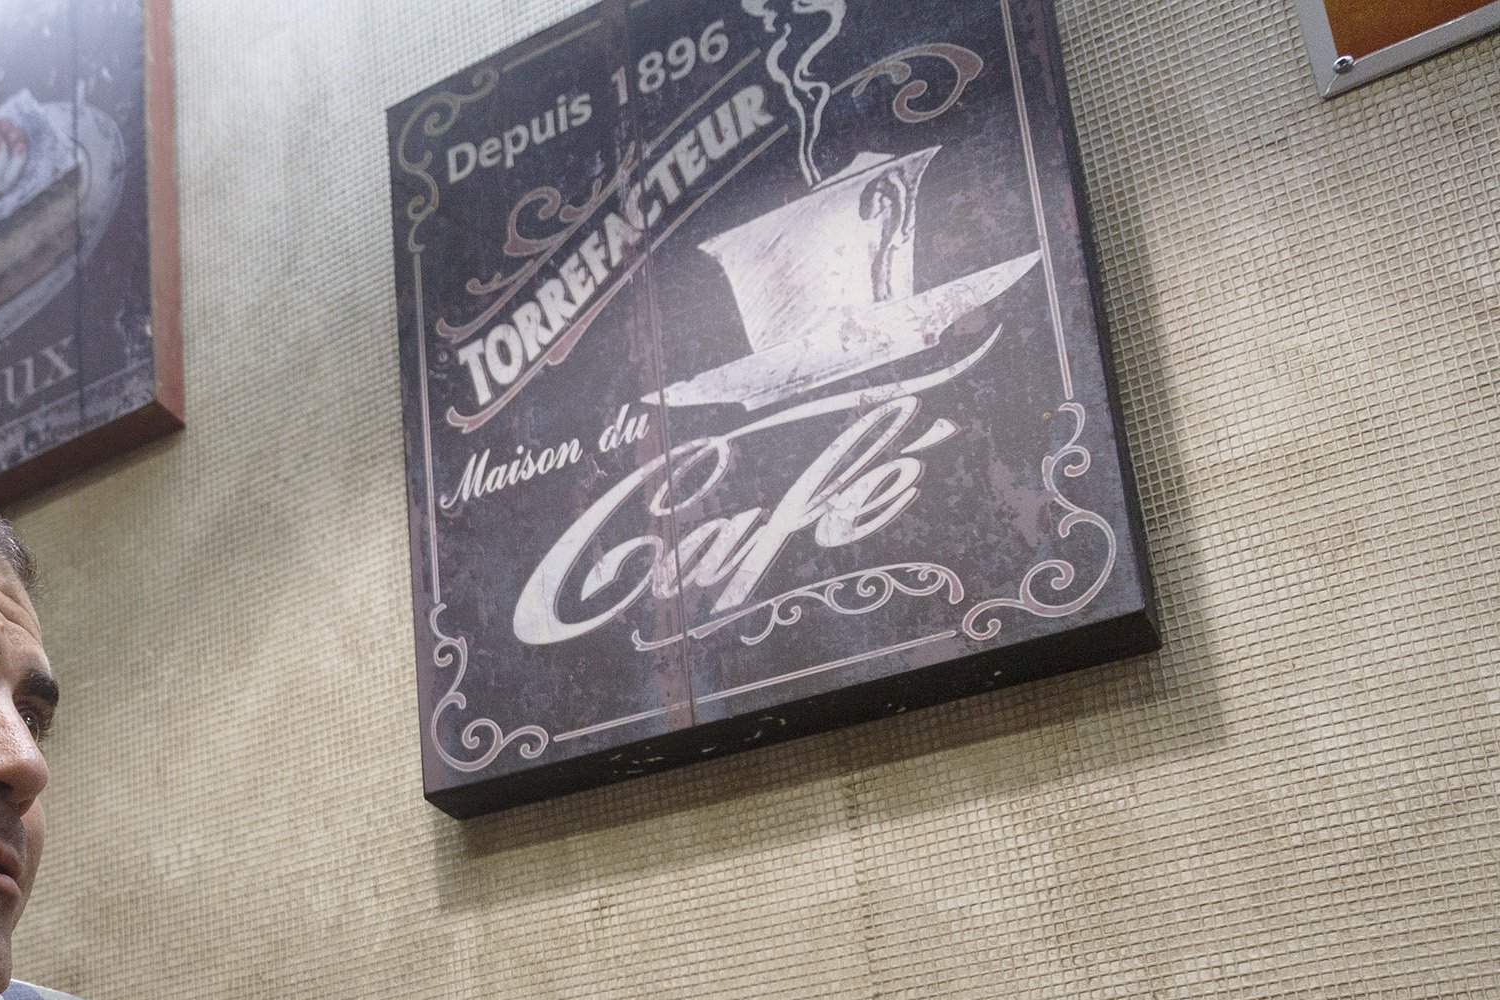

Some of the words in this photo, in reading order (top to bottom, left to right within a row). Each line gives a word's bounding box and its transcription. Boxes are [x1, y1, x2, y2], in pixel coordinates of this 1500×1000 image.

[445, 88, 594, 184] Depuis
[610, 22, 731, 108] 1896
[457, 82, 777, 406] TORREFACTEUR
[440, 438, 584, 510] Maison
[598, 402, 650, 455] du
[512, 394, 960, 646] Café
